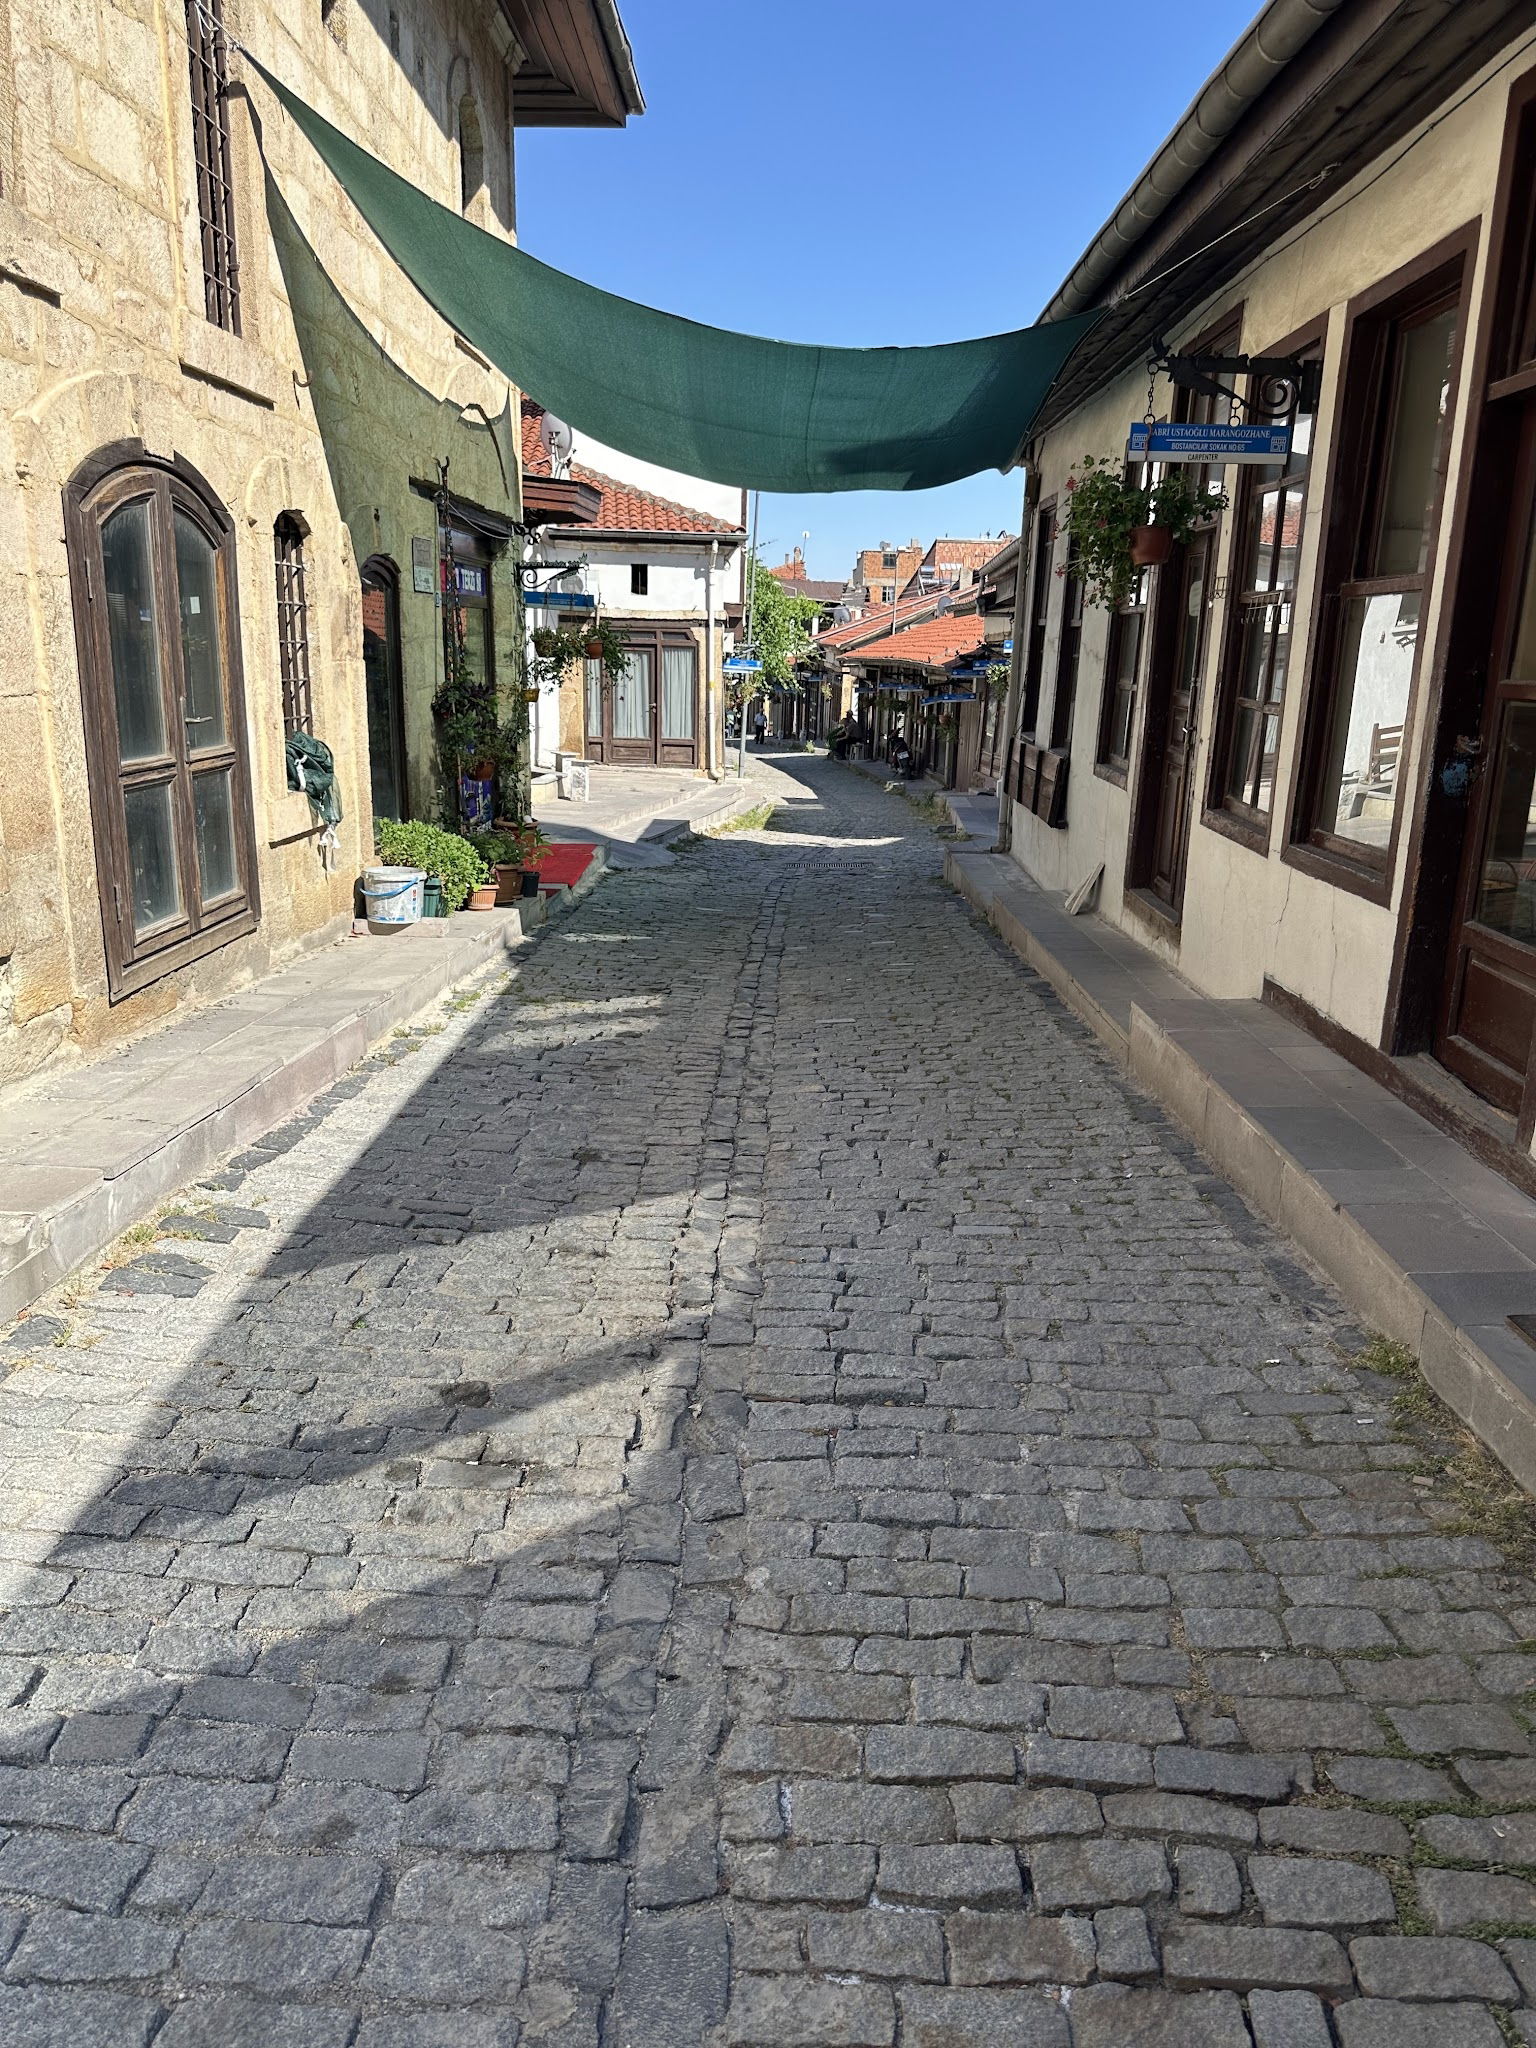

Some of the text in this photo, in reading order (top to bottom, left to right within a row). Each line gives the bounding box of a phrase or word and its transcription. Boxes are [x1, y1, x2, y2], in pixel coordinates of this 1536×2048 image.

[1151, 426, 1271, 439] ABRİ USTAOĞLU MARANGOZHANE
[1171, 442, 1209, 451] BOSTANCILAR
[1209, 443, 1228, 451] SOKAK
[1187, 453, 1219, 461] CARPENTER
